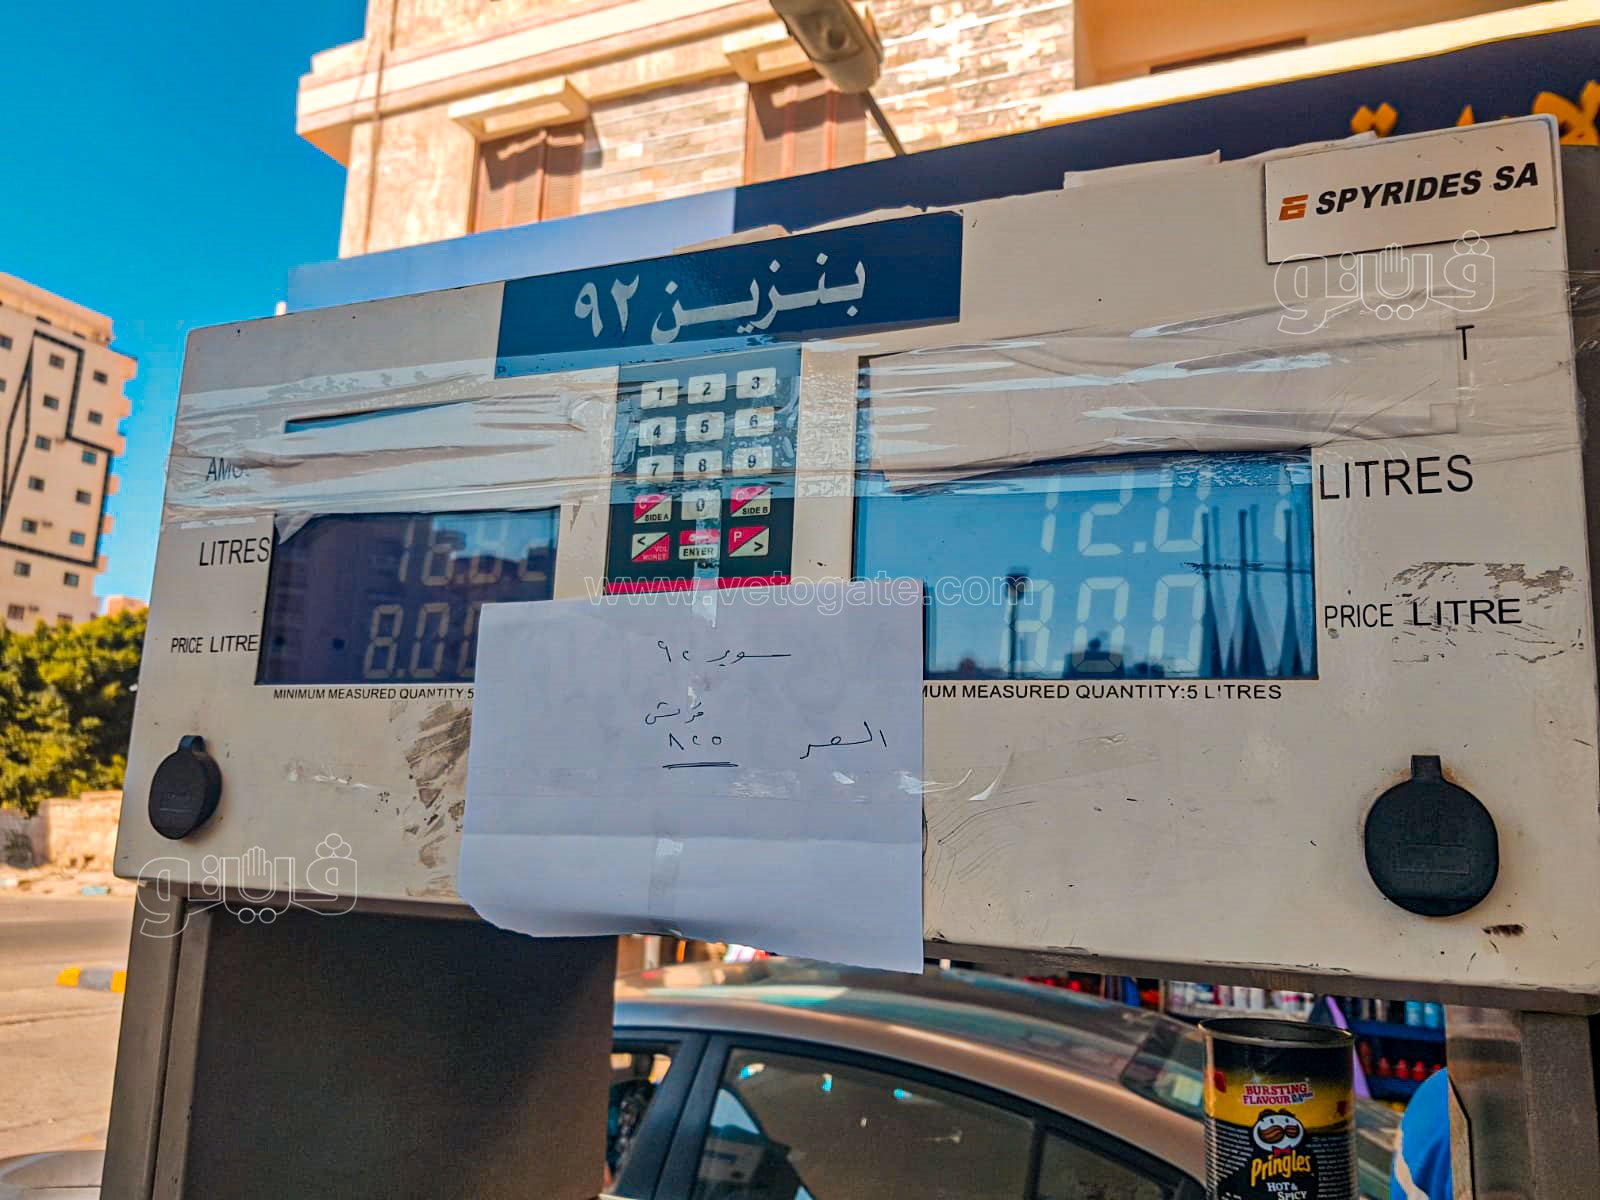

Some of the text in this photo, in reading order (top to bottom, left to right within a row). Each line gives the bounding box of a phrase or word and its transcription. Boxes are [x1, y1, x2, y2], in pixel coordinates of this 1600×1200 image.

[1316, 162, 1539, 215] SPYRIDES SA
[575, 253, 866, 344] بنزين ٩٢
[703, 382, 712, 396] 2
[751, 376, 760, 390] 3
[653, 424, 661, 438] 4
[700, 419, 709, 433] 5
[698, 459, 707, 472] 8
[1319, 454, 1474, 499] LITRES
[645, 514, 662, 522] SIDE
[742, 507, 760, 515] SIDE
[199, 537, 271, 566] LITRES
[683, 548, 714, 557] ENTER
[1324, 598, 1522, 628] PRICE LITRE
[171, 634, 260, 653] PRICE LITRE
[273, 688, 325, 699] MINIMUM
[328, 688, 396, 699] MEASURED
[962, 685, 1070, 699] MEASURED
[1245, 1083, 1307, 1096] BURSTING
[1243, 1095, 1291, 1105] FLAVOUR
[1251, 1149, 1311, 1187] Pringles
[1277, 1191, 1307, 1200] SPICY
